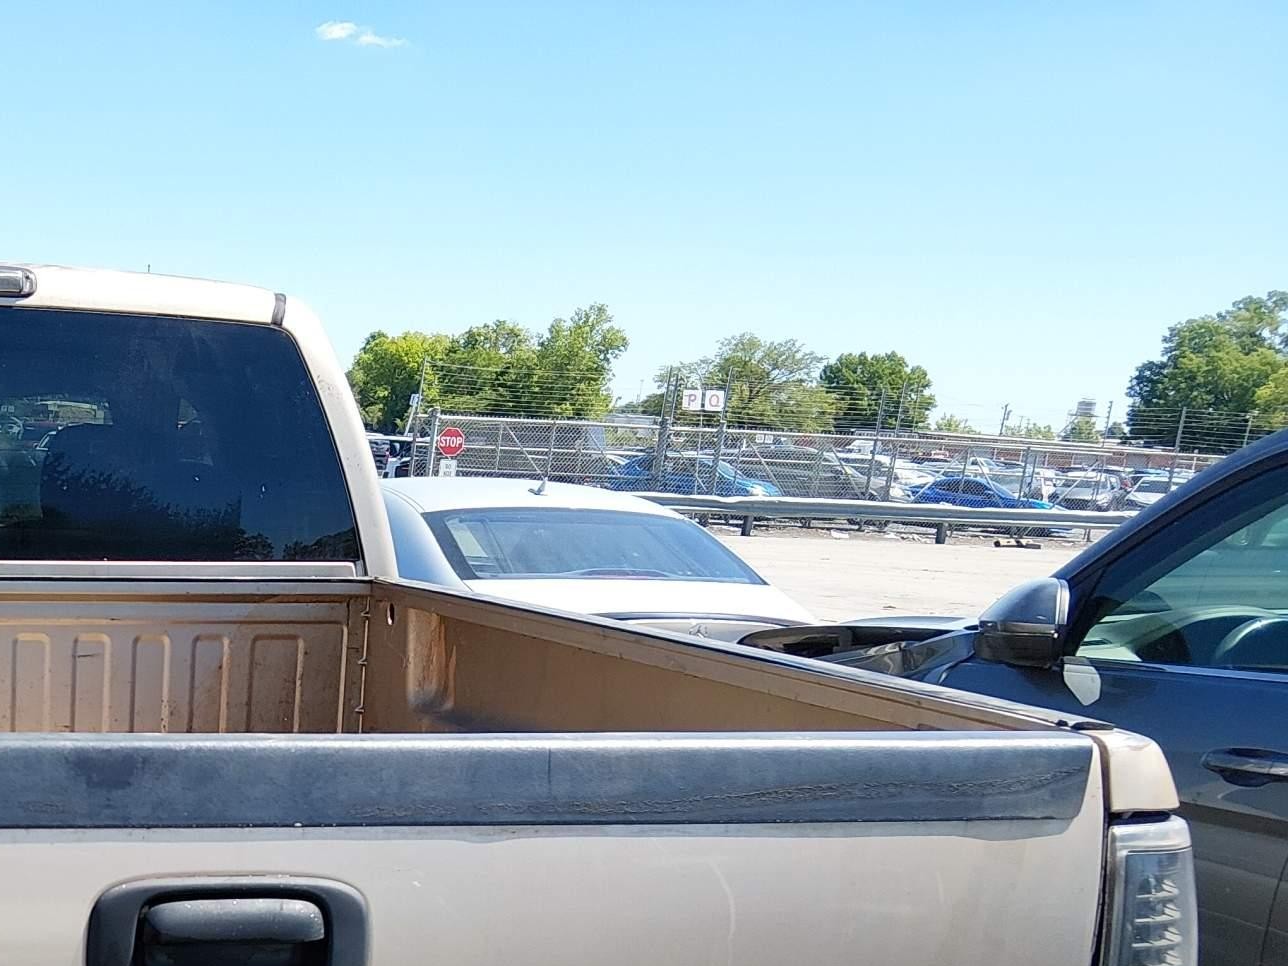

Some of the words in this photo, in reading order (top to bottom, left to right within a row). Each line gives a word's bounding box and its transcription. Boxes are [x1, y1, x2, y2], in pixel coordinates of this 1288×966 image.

[688, 393, 697, 407] P
[709, 394, 721, 408] Q
[440, 436, 463, 448] STOP
